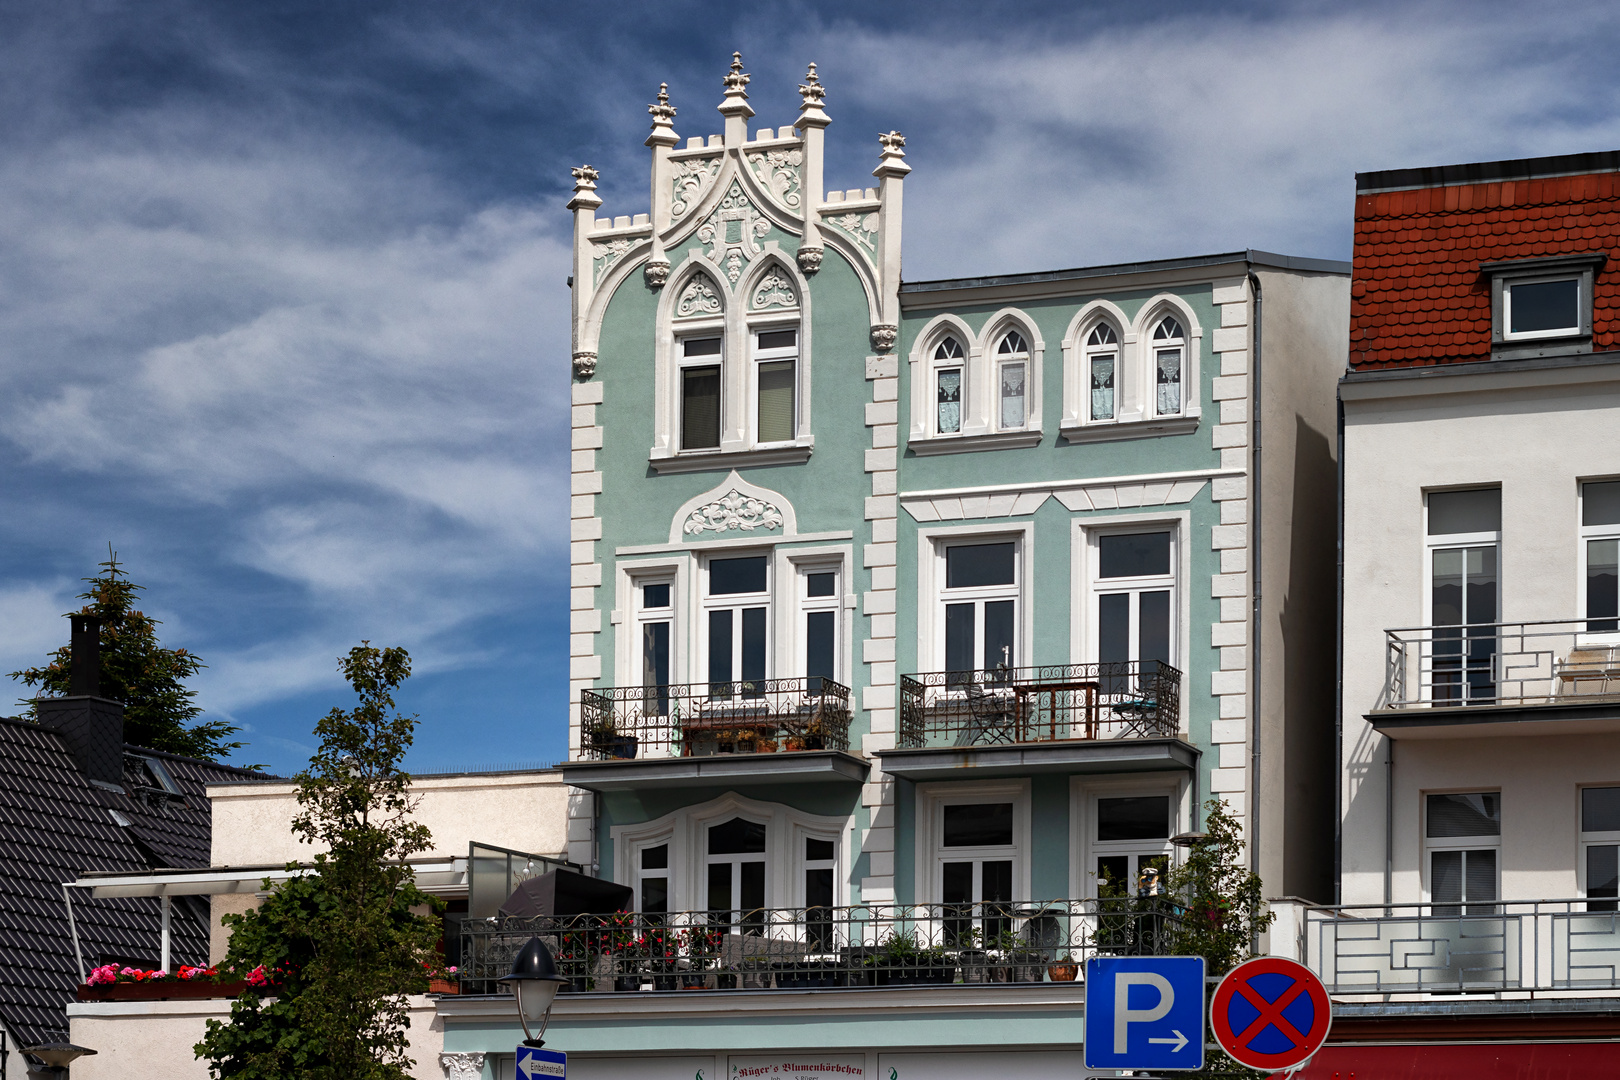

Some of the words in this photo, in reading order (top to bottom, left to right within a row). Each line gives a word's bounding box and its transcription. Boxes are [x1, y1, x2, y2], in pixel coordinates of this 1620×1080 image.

[1113, 972, 1175, 1054] P
[531, 1062, 563, 1075] Einbahnstraße
[782, 1063, 863, 1076] Blumenkörbchen
